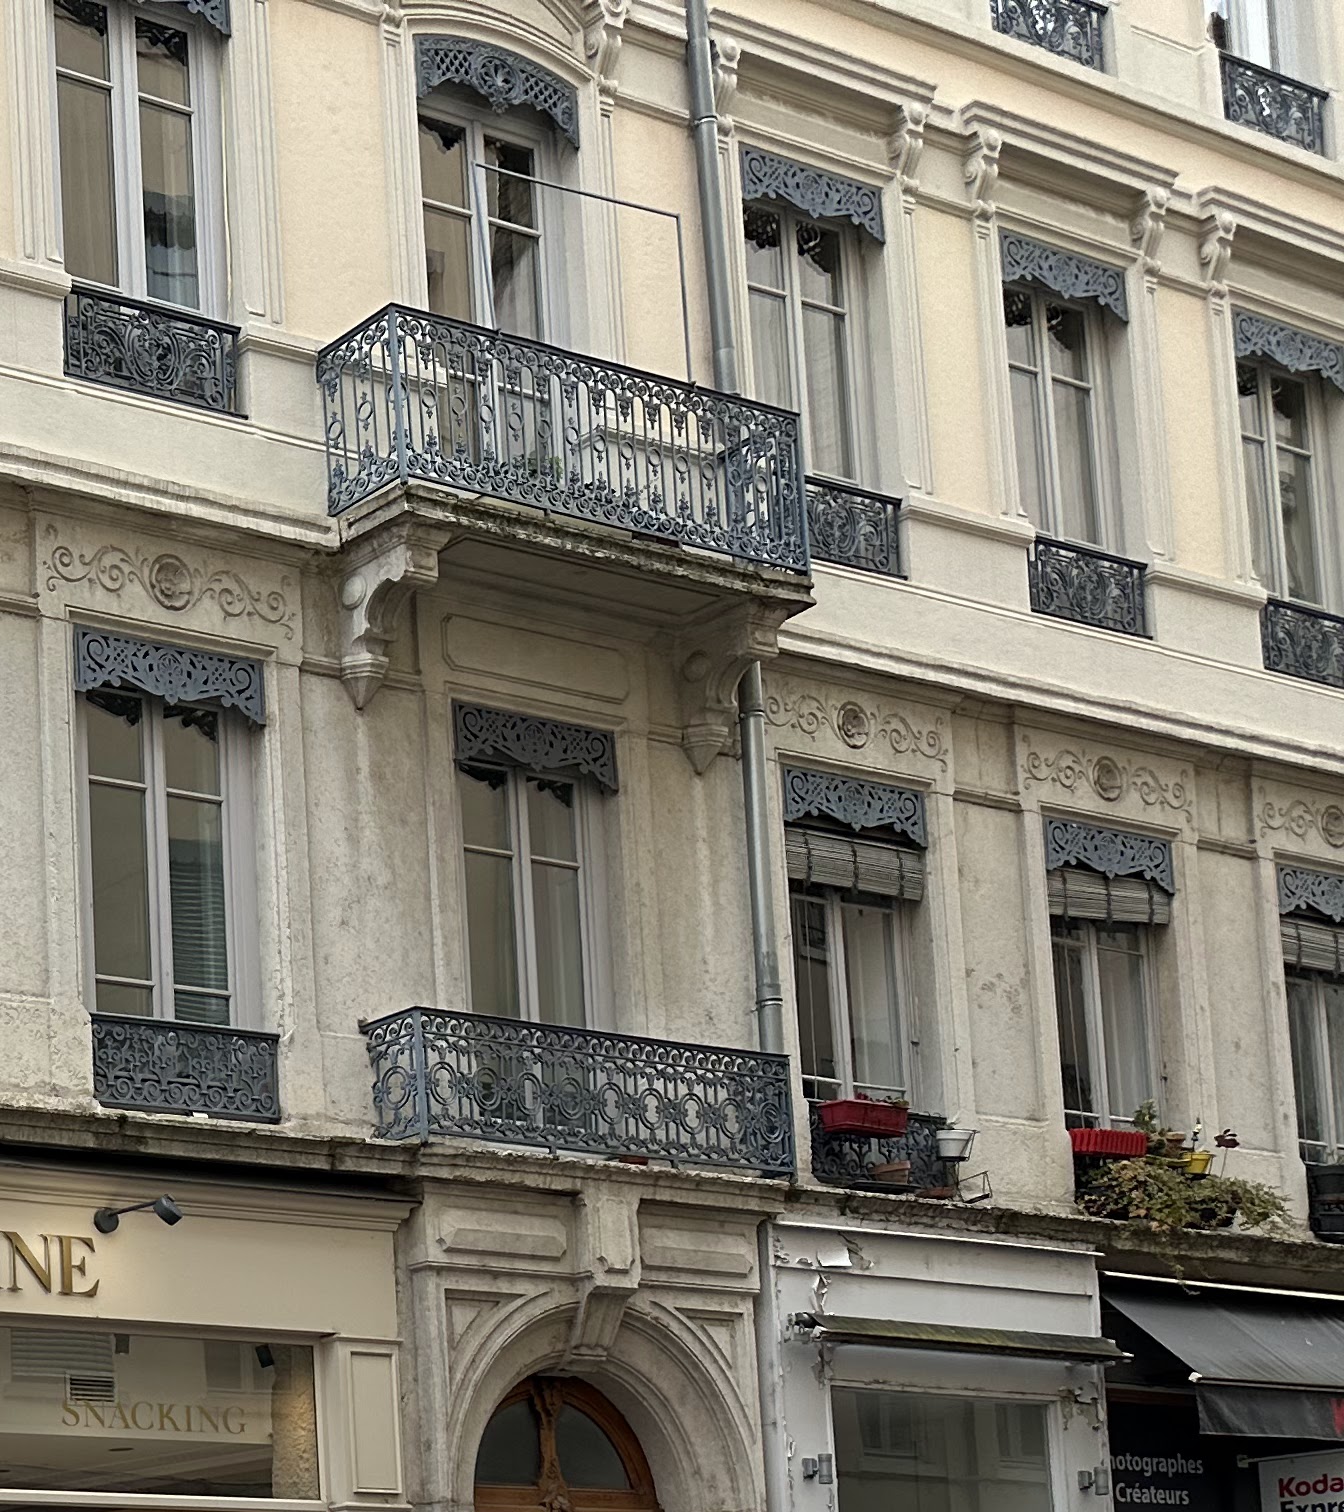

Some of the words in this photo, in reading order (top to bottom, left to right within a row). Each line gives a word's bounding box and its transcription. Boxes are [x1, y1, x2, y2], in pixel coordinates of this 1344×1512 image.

[62, 1400, 247, 1435] SNACKING
[1110, 1452, 1204, 1478] otographes
[1115, 1482, 1190, 1506] Créateurs
